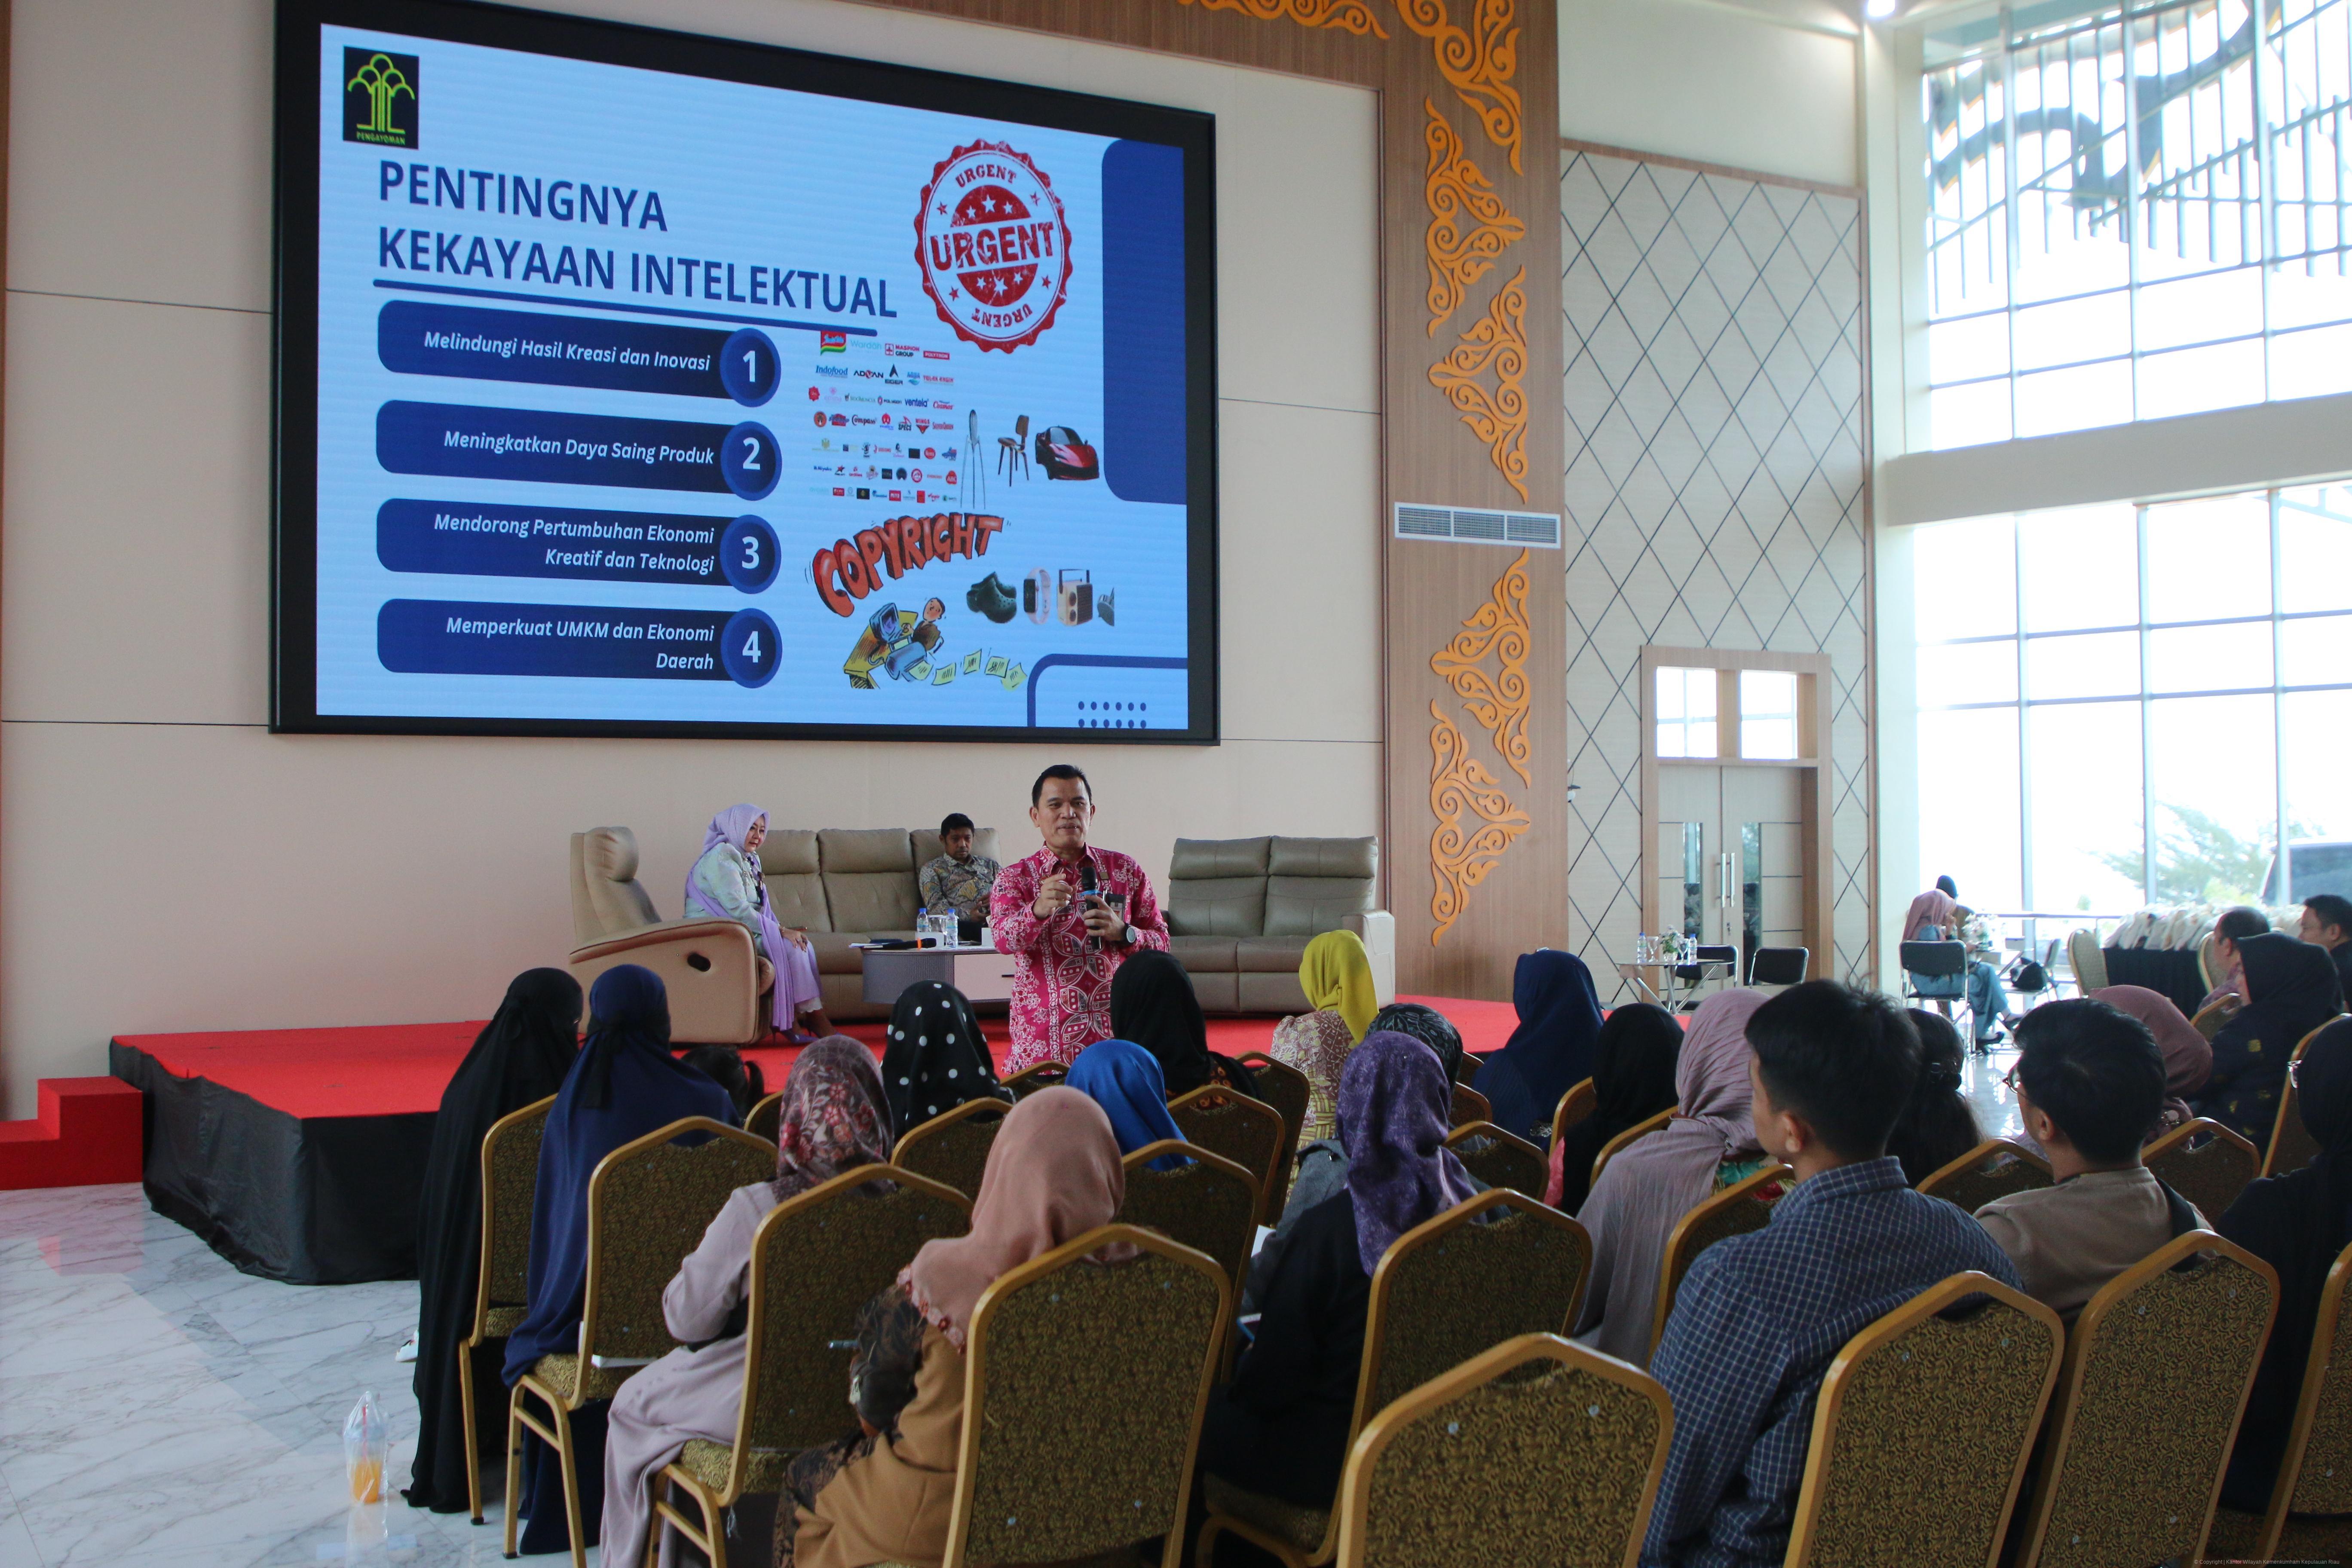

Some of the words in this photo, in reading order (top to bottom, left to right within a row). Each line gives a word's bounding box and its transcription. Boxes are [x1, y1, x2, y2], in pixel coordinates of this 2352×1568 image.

[356, 131, 406, 146] PENGAYOMAN
[955, 164, 1017, 188] URGENT
[380, 160, 668, 232] PENTINGNYA
[930, 221, 1054, 271] URGENT
[380, 227, 614, 289] KEKAYAAN
[632, 253, 897, 318] INTELEKTUAL
[972, 303, 1033, 328] URGENT
[424, 331, 518, 356] Melindungi
[521, 340, 562, 358] Hasil
[566, 343, 617, 363] Kreasi
[620, 348, 650, 366] dan
[654, 352, 710, 371] Inovasi
[742, 350, 756, 383] 1
[816, 365, 848, 377] Indofood
[851, 414, 876, 426] Compass
[444, 431, 561, 454] Meningkatkan
[565, 439, 608, 460] Daya
[611, 442, 656, 464] Saing
[659, 446, 714, 464] Produk
[742, 437, 761, 470] 2
[434, 514, 530, 538] Mendorong
[533, 519, 643, 540] Pertumbuhan
[647, 524, 714, 544] Ekonomi
[545, 548, 603, 567] Kreatif
[605, 551, 635, 568] dan
[640, 553, 715, 576] Teknologi
[741, 536, 760, 569] 3
[812, 512, 1004, 618] COPYRIGHT
[446, 617, 553, 638] Memperkuat
[557, 621, 609, 638] UMKM
[612, 622, 643, 639] dan
[647, 623, 715, 641] Ekonomi
[656, 653, 714, 669] Daerah
[742, 631, 761, 663] 4
